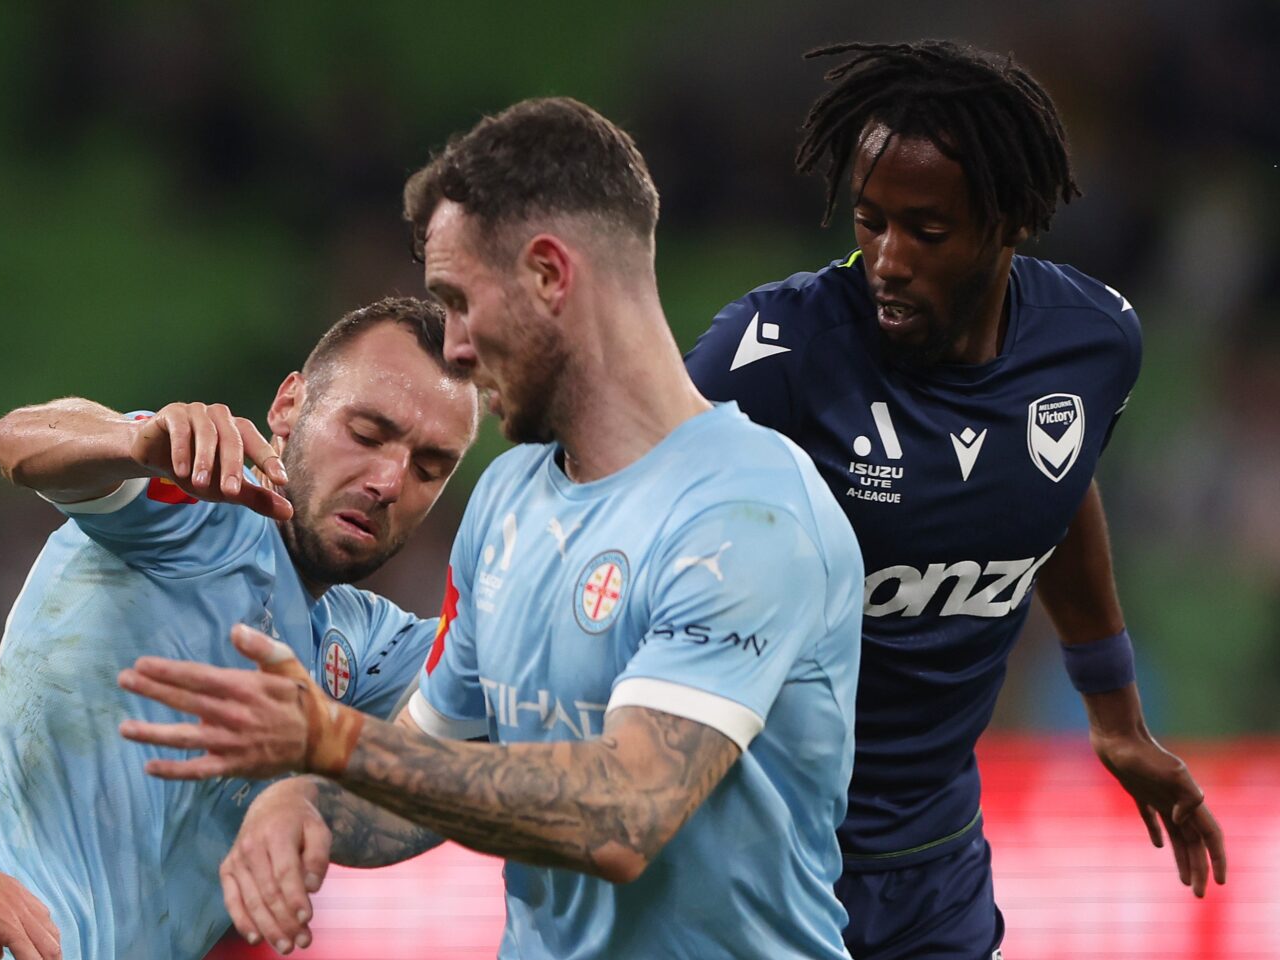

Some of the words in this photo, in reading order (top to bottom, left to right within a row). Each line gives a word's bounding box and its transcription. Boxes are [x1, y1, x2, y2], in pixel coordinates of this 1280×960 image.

[1038, 410, 1075, 425] Victory
[849, 461, 904, 479] ISUZU
[860, 476, 892, 489] UTE
[846, 487, 902, 504] A-LEAGUE
[864, 546, 1057, 618] onz
